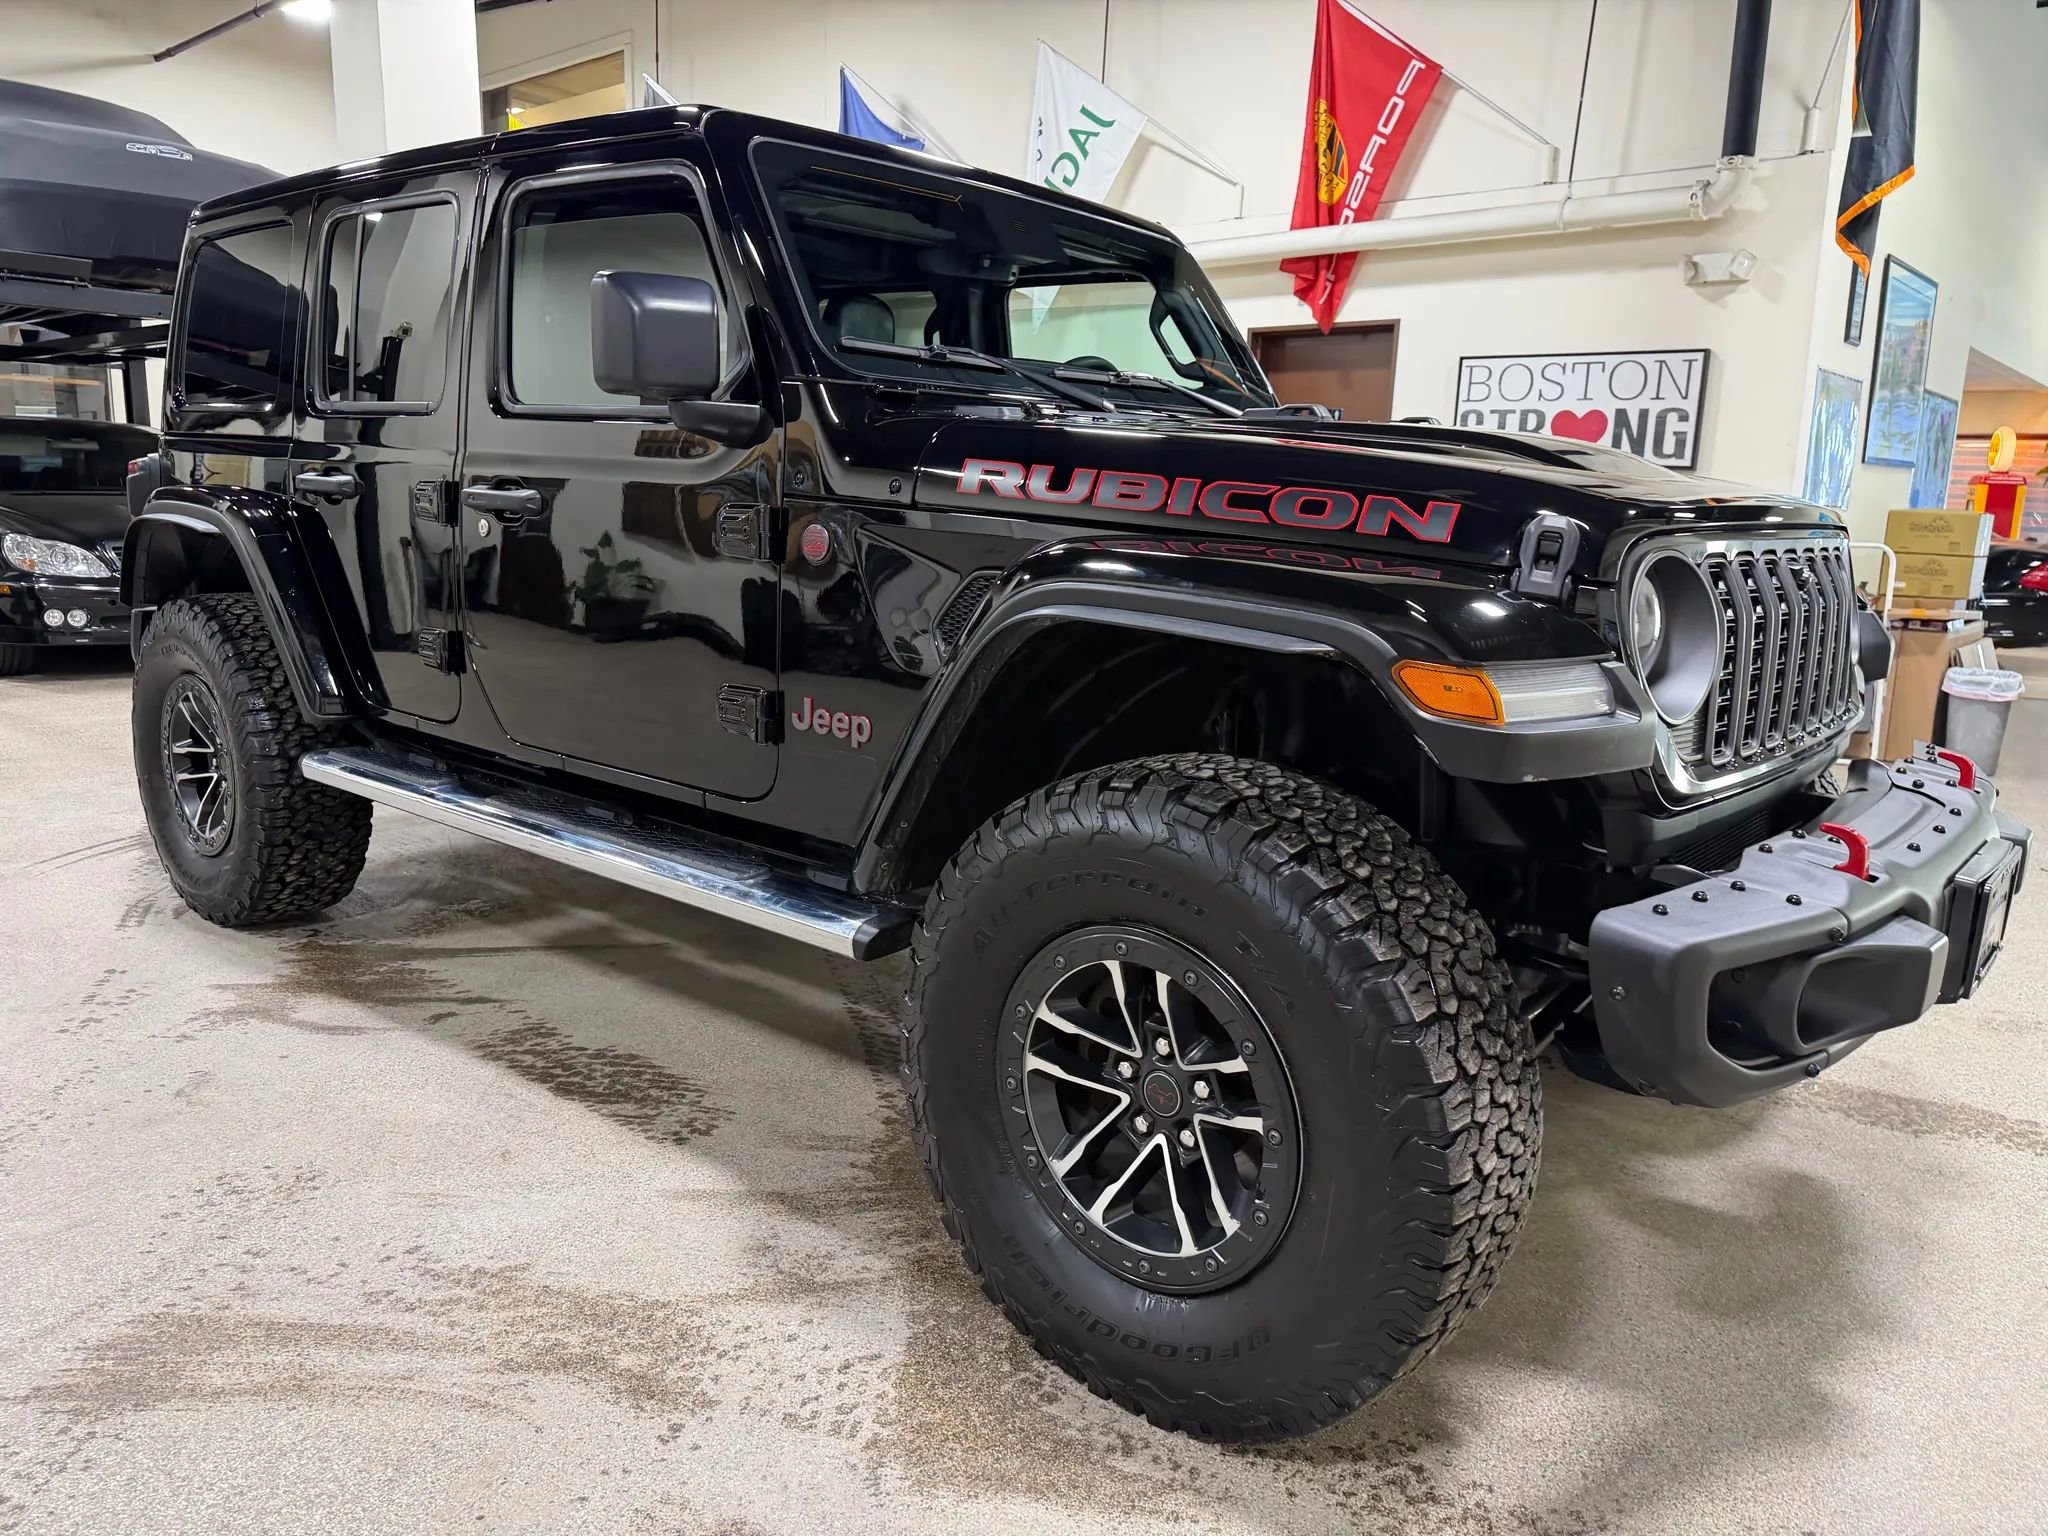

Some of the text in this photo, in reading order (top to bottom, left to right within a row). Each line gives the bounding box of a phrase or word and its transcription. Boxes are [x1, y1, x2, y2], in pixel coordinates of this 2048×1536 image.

[1461, 359, 1699, 403] BOSTON
[956, 458, 1462, 543] RUBICON
[791, 696, 873, 749] Jeep
